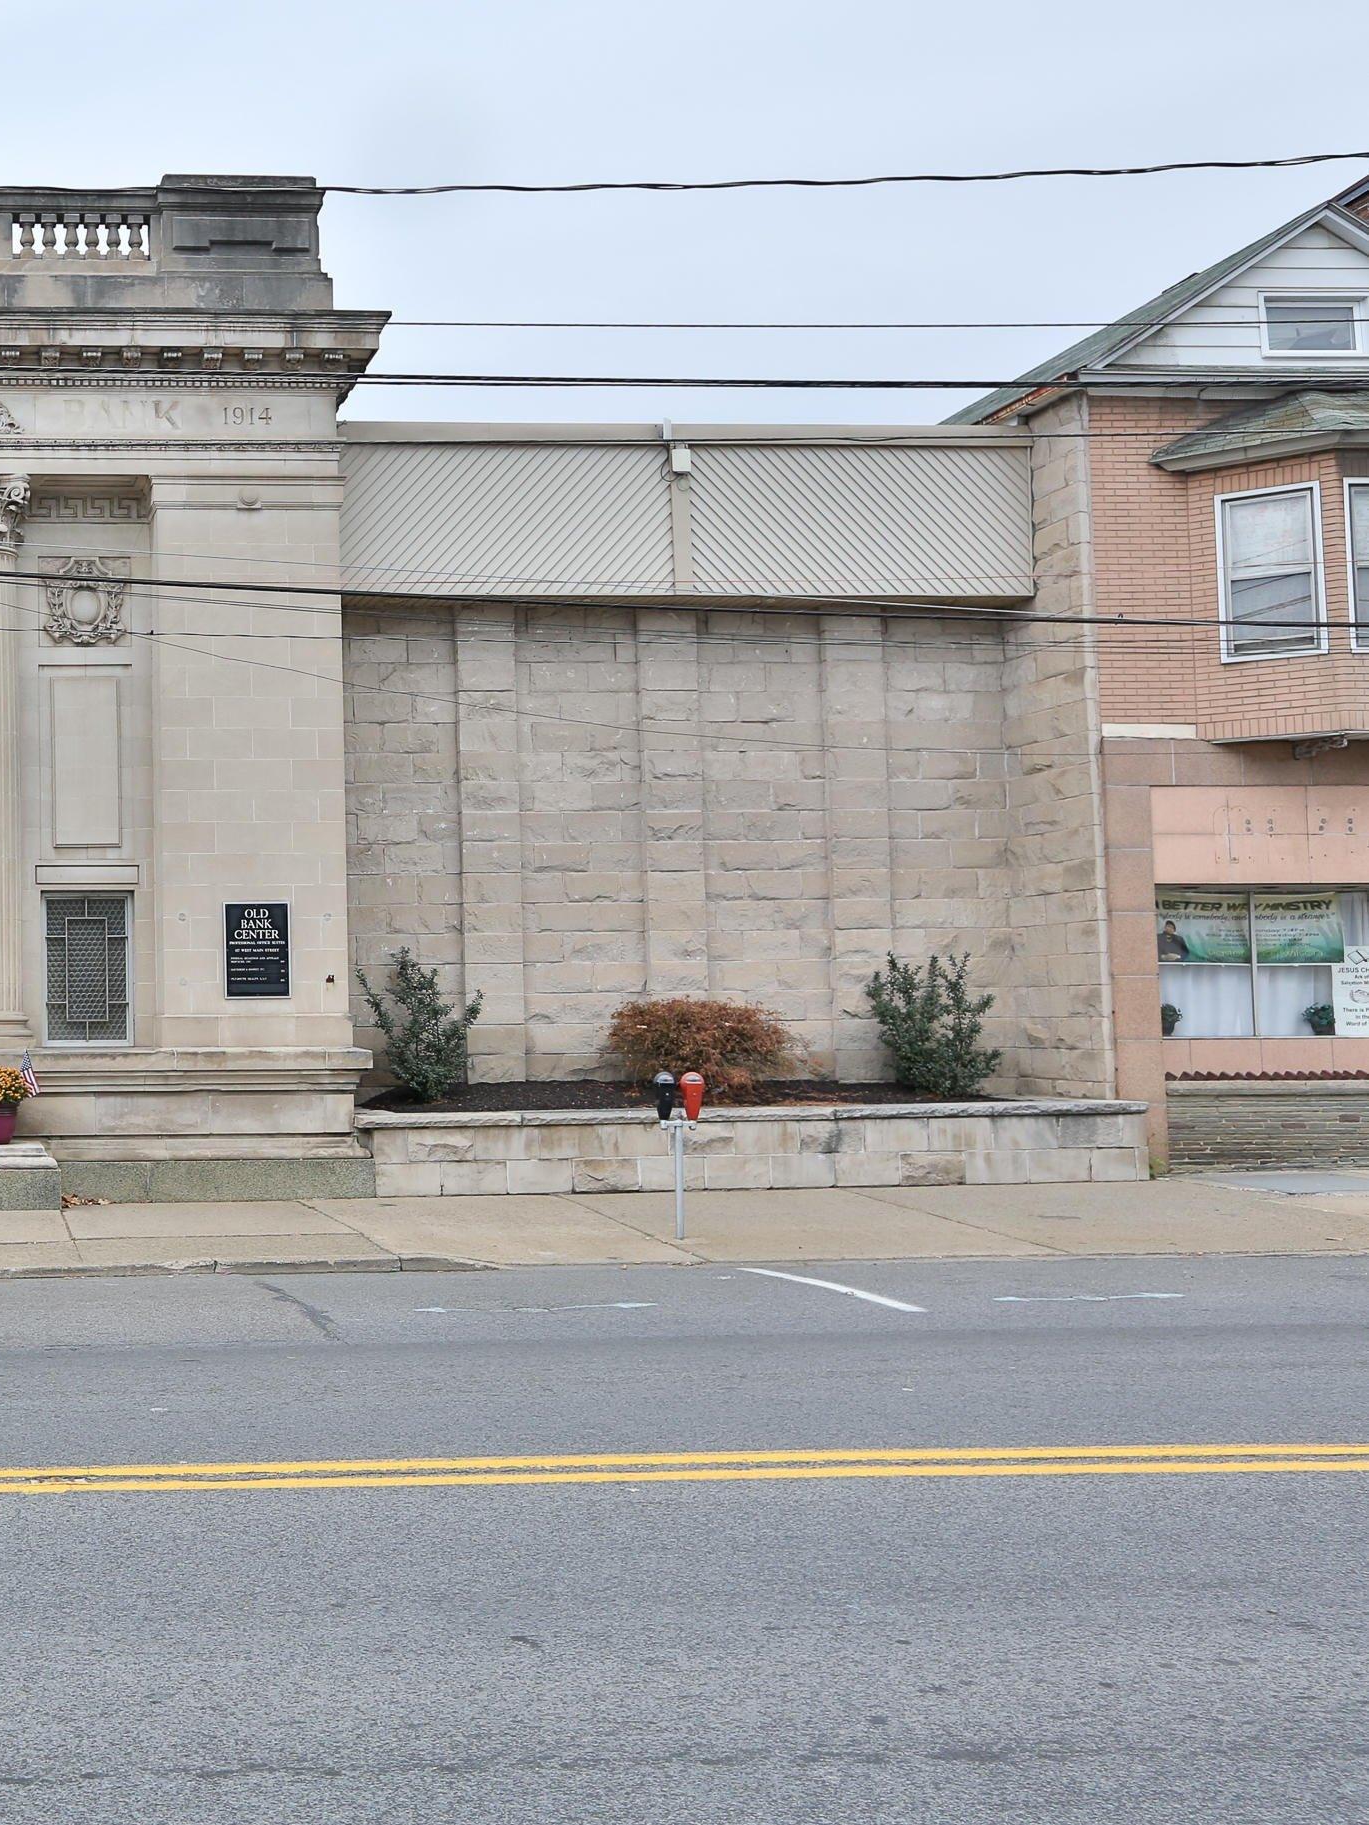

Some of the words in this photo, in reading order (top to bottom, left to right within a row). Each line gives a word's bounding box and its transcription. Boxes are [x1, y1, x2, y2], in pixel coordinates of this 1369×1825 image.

[223, 406, 272, 425] 1914
[1162, 900, 1223, 911] BETTER
[244, 908, 269, 919] OLD
[240, 919, 273, 929] BANK
[234, 929, 279, 939] CENTER
